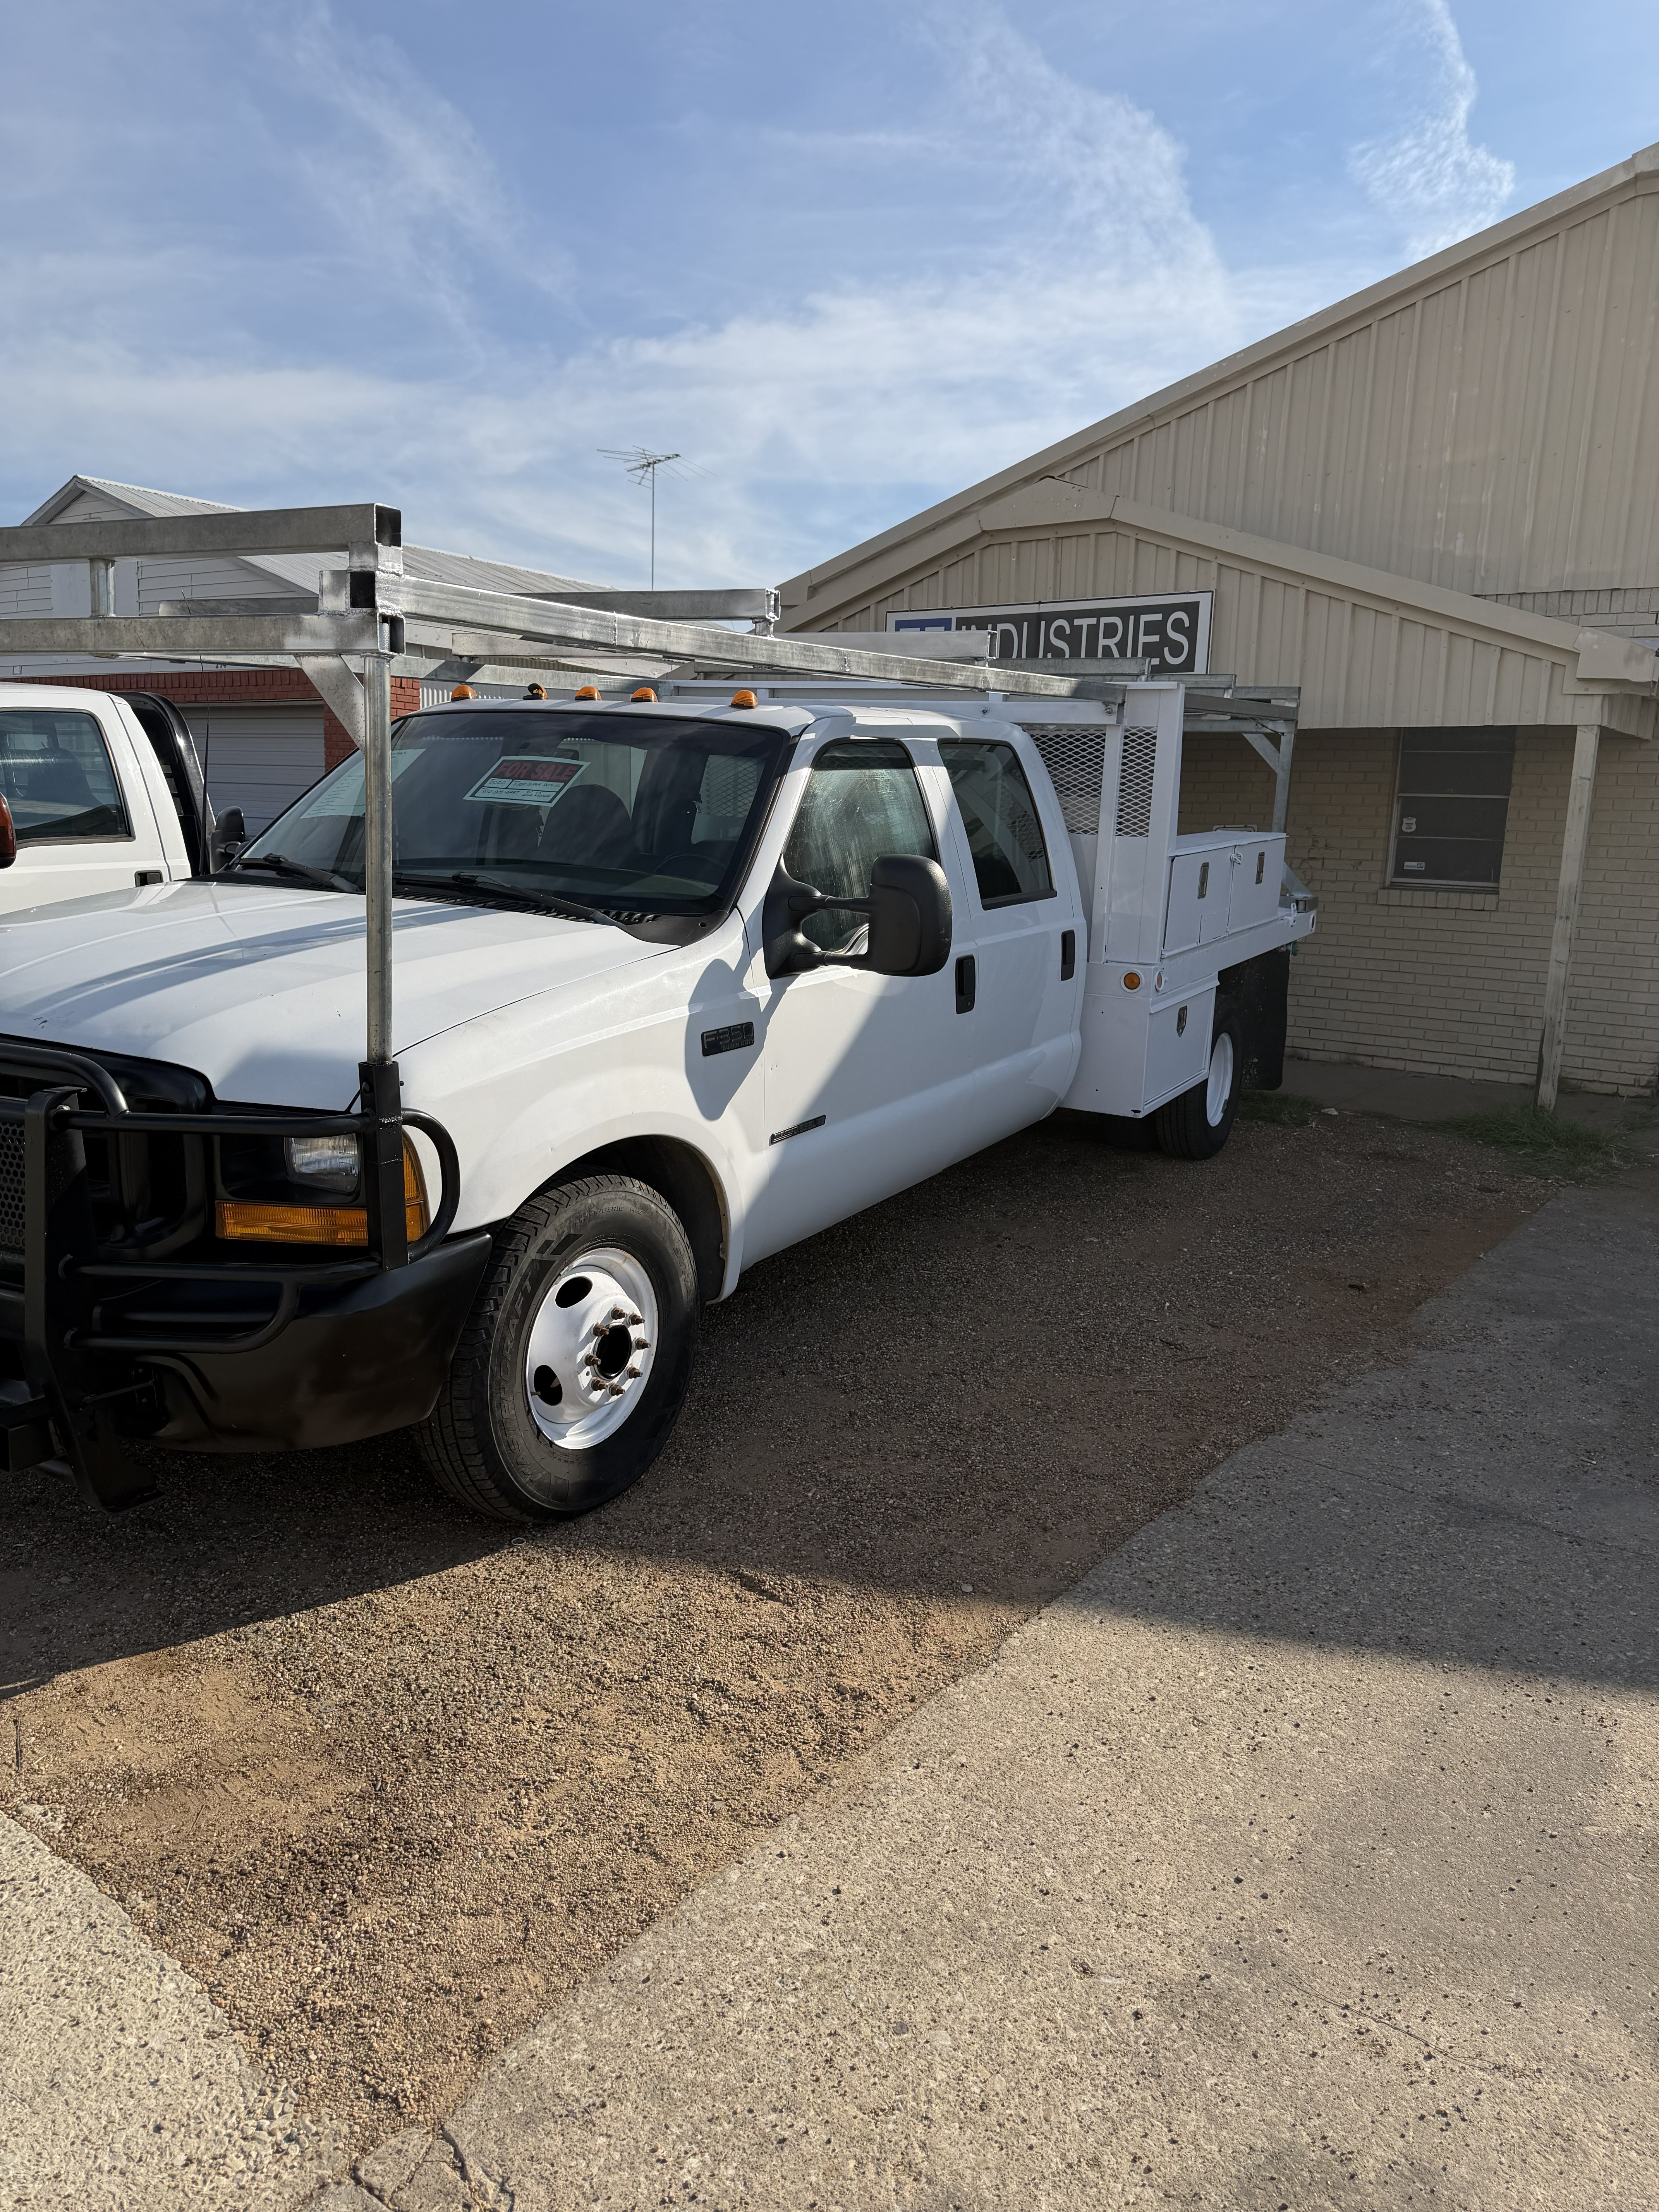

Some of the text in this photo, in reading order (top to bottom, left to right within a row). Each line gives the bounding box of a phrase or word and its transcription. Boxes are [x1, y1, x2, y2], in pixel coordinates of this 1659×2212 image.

[962, 611, 1190, 665] DUSTRIES
[493, 763, 577, 781] FOR SALE
